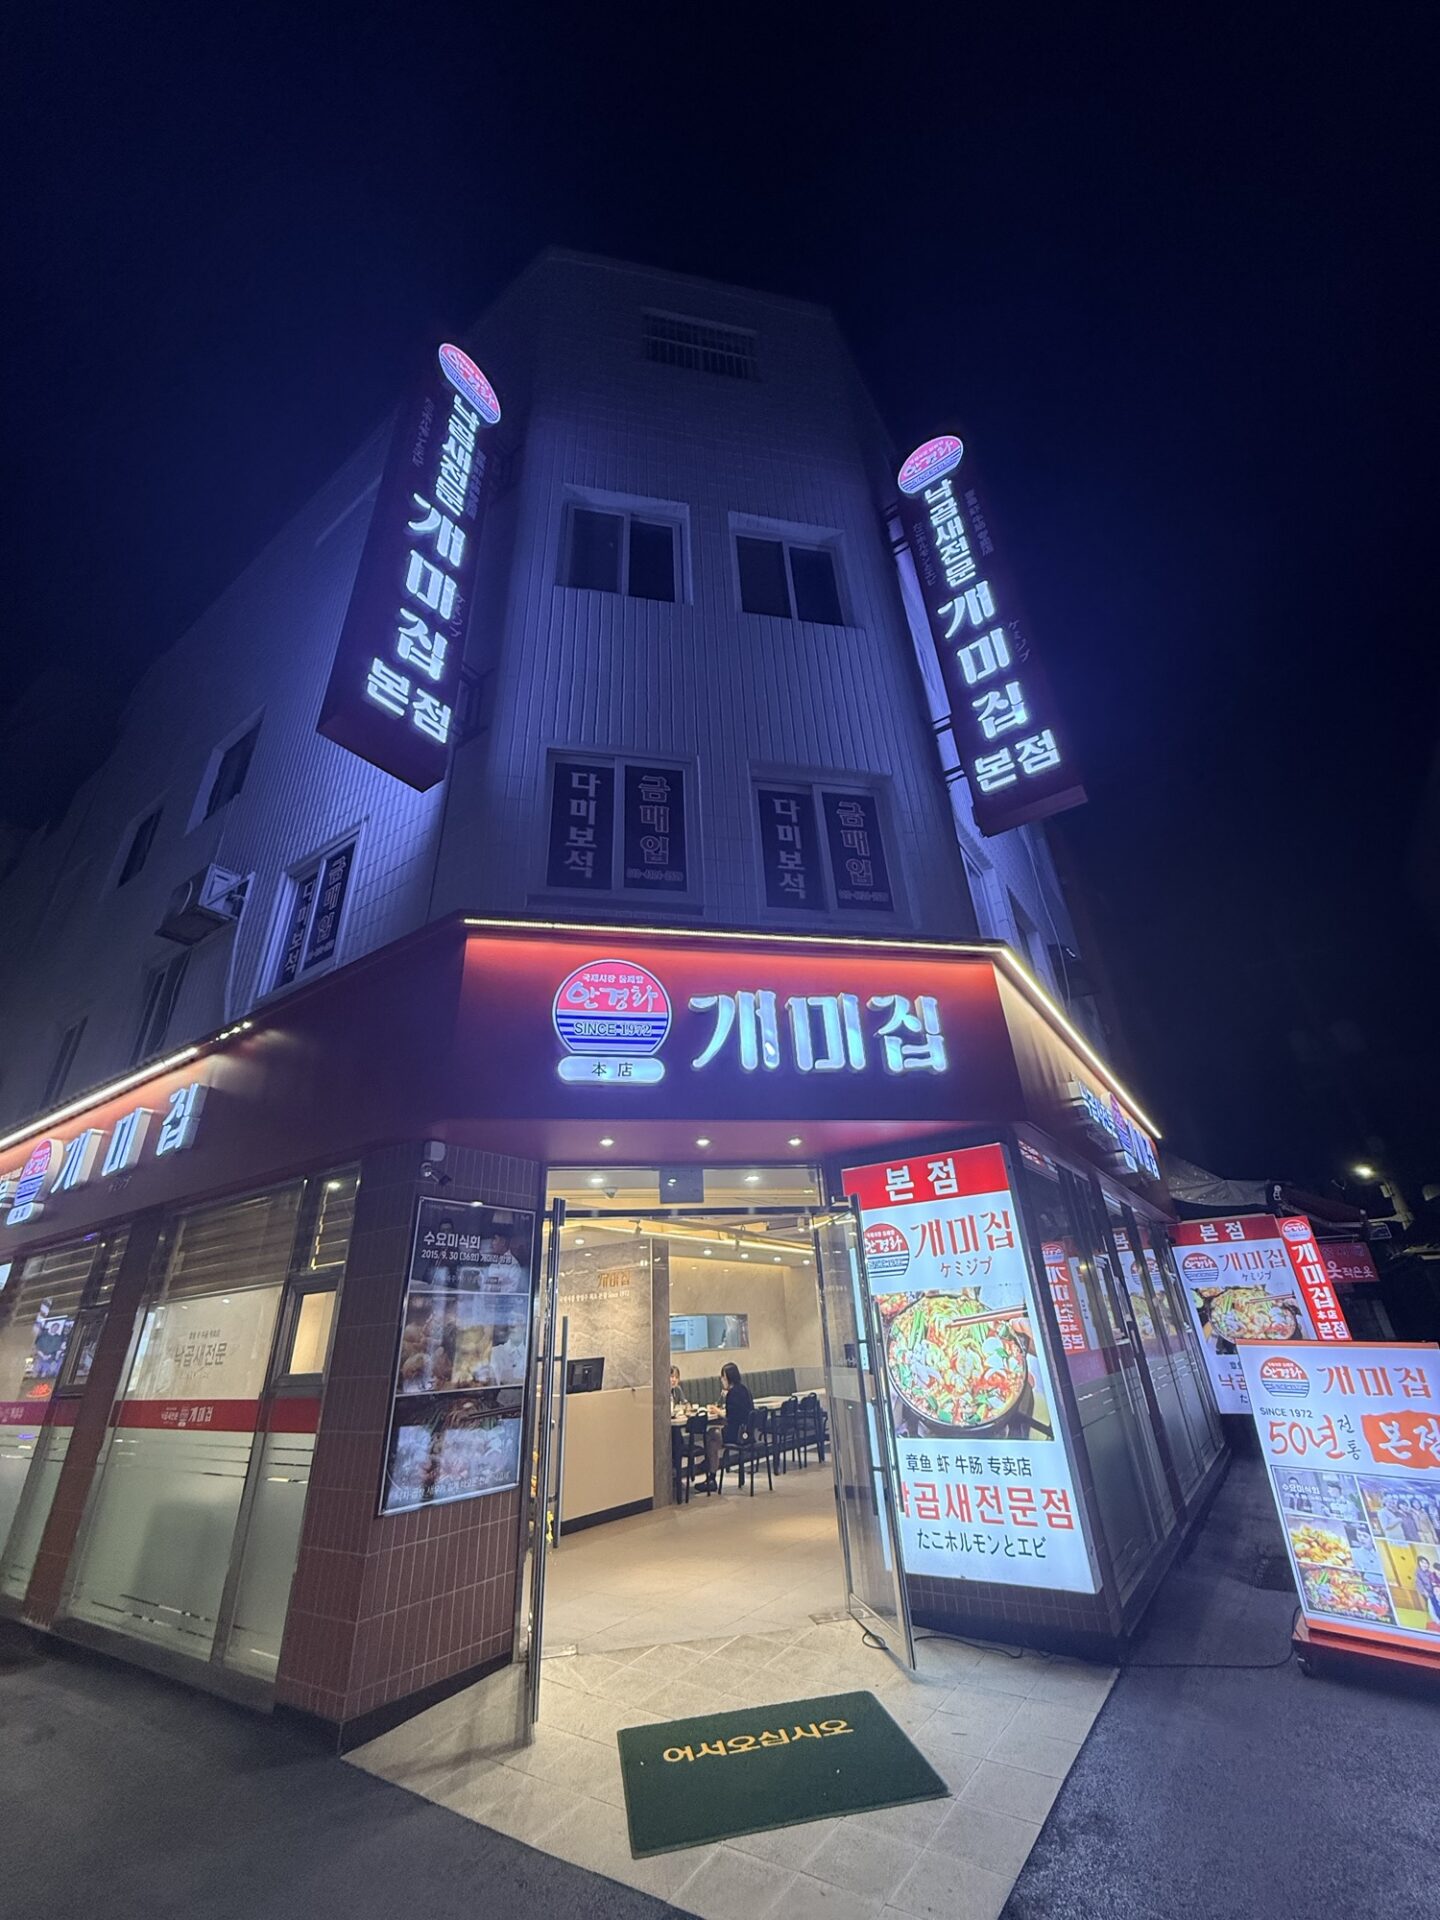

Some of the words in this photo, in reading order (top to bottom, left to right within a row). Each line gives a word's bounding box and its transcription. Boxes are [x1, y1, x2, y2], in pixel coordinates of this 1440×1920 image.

[924, 478, 976, 587] 낙곱새전문
[398, 493, 465, 680] 개미집
[938, 580, 1029, 738] 개미집
[367, 657, 452, 743] 본점
[975, 729, 1061, 793] 본점
[564, 772, 601, 878] 다미보석
[772, 798, 806, 899] 다미보석
[566, 981, 659, 1012] 안경화
[574, 1022, 616, 1035] SINCE
[620, 1024, 652, 1036] 1972
[688, 989, 947, 1073] 개미집
[591, 1062, 633, 1077] 本店
[51, 1083, 205, 1193] 개미집
[423, 1231, 481, 1250] 수요미식회
[910, 1210, 1014, 1258] 개미집
[1200, 1221, 1245, 1242] 본점
[1218, 1249, 1287, 1272] 개미집
[1291, 1242, 1335, 1309] 개미집
[1317, 1321, 1349, 1340] 본점
[1317, 1365, 1432, 1398] 개미집
[1259, 1407, 1287, 1417] SINCE
[1289, 1408, 1313, 1418] 1972
[1269, 1414, 1347, 1460] 50년
[905, 1453, 933, 1473] 章鱼
[937, 1454, 950, 1474] 虾
[955, 1455, 983, 1475] 牛肠
[987, 1456, 1032, 1478] 专卖店
[917, 1528, 1047, 1559] たこホルモンとエビ
[662, 1719, 854, 1762] 어서오십시오
